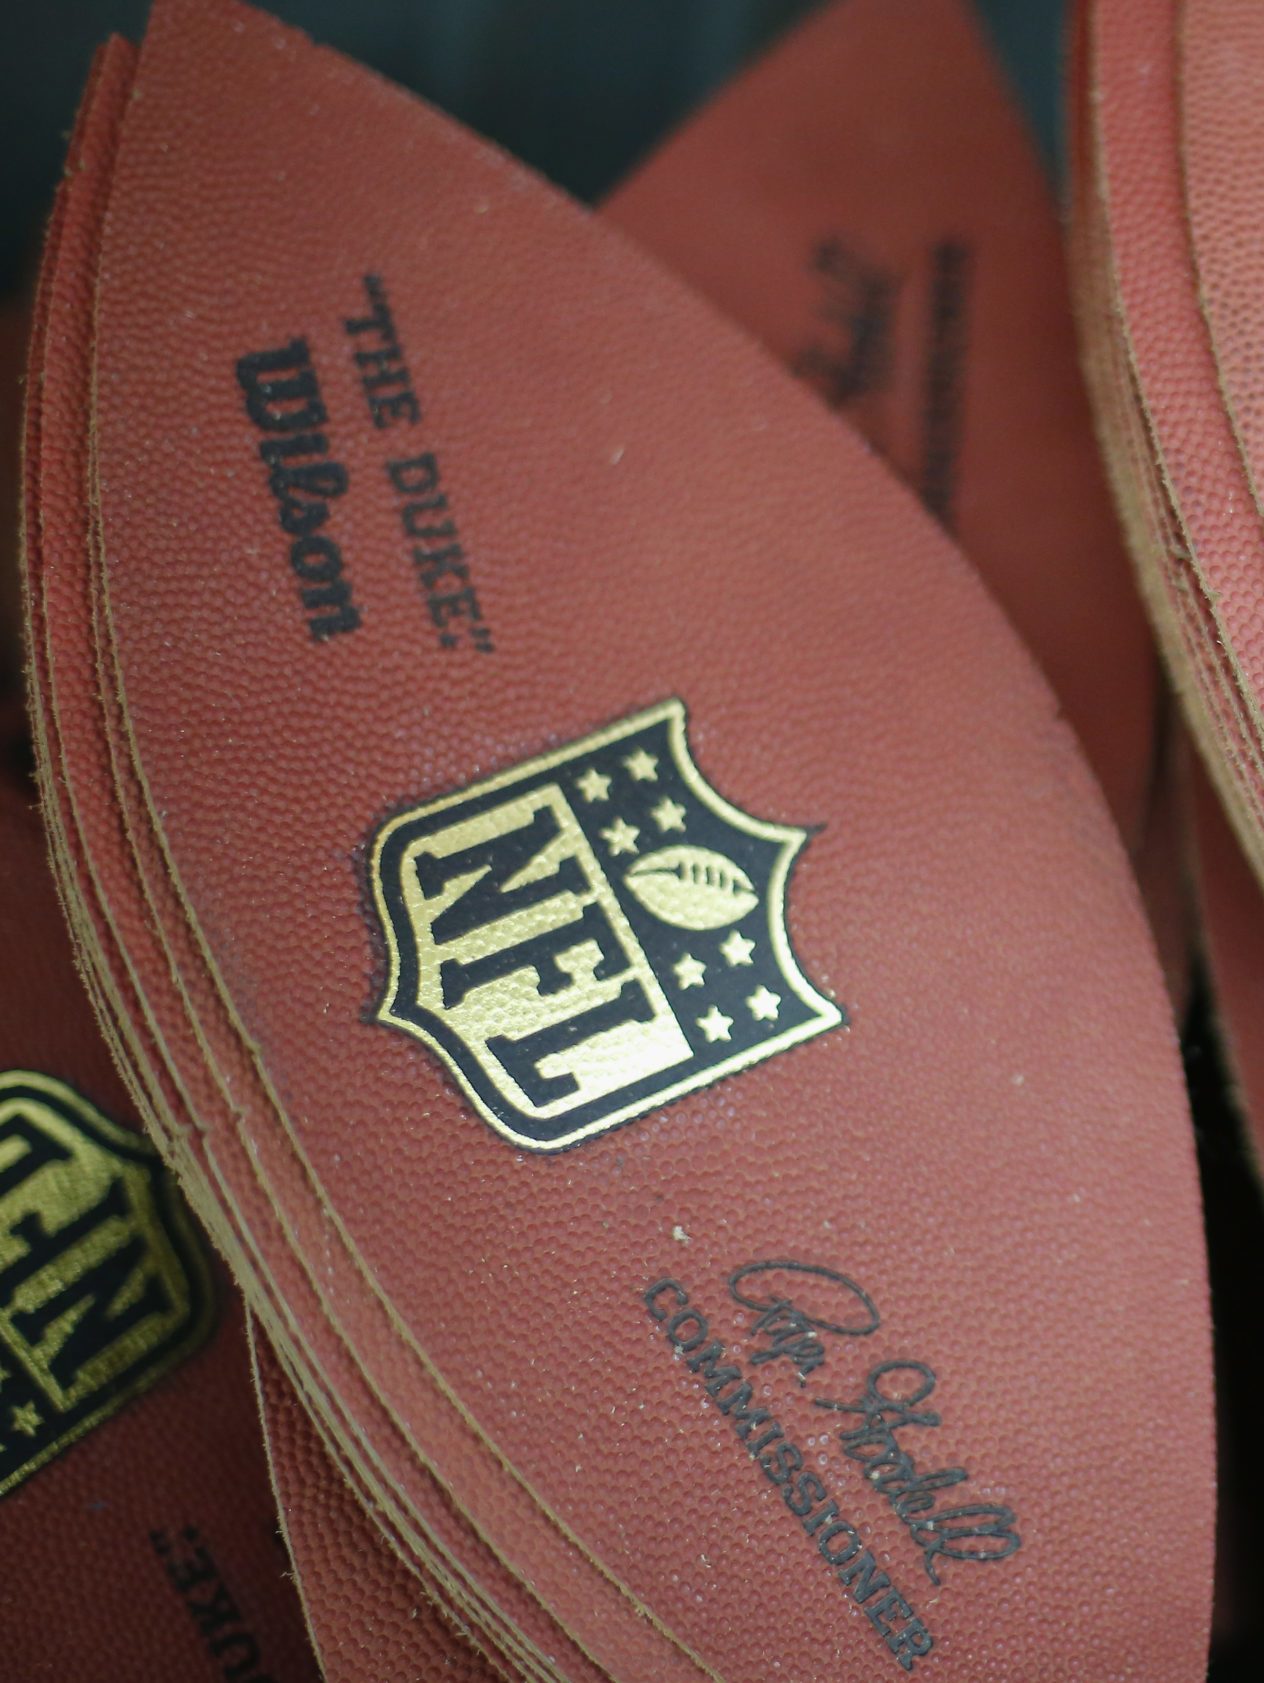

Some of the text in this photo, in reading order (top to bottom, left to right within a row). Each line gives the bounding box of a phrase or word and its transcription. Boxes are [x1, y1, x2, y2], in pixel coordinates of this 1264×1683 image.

[236, 337, 362, 643] Wilson
[413, 805, 656, 1108] NFL
[642, 1276, 934, 1672] COMMISSIONER
